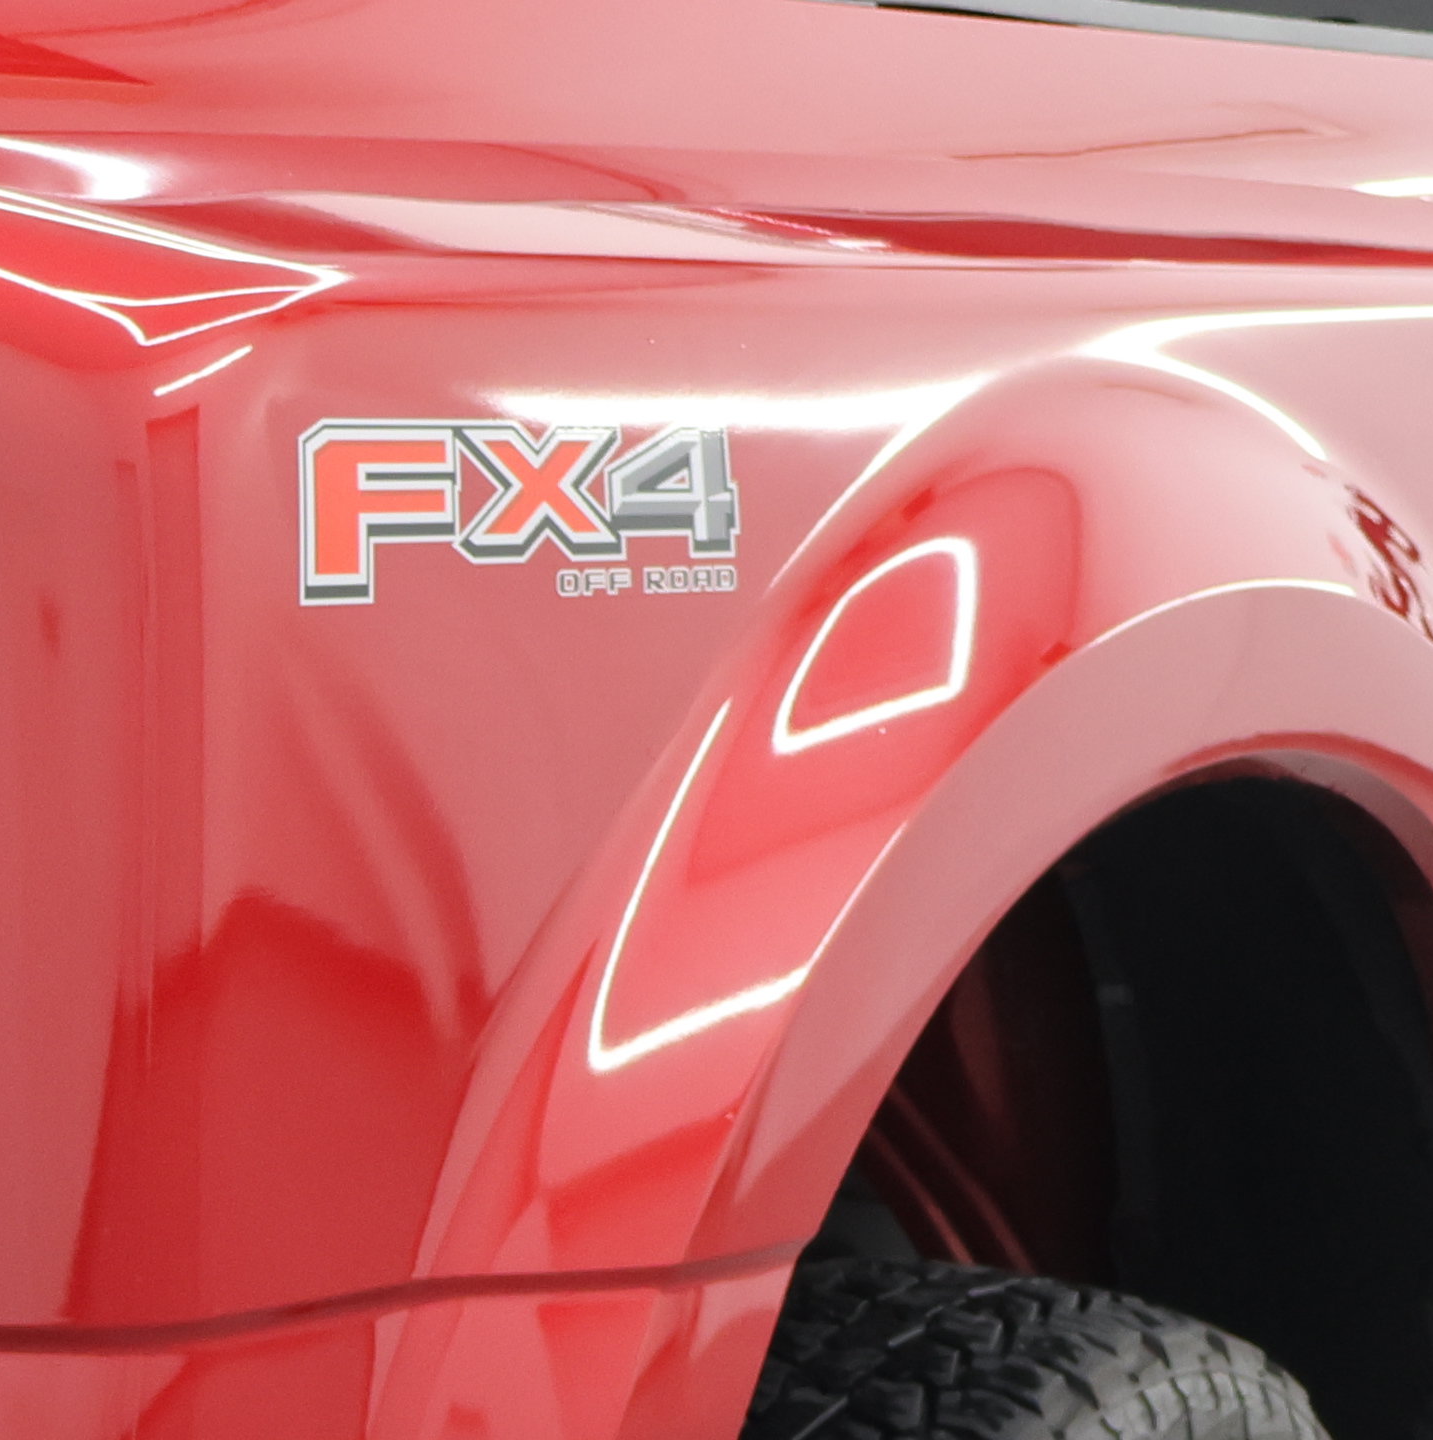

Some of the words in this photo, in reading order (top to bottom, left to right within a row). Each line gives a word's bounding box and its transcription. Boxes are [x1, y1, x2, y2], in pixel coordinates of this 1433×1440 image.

[299, 418, 741, 606] FX4
[556, 568, 632, 597] OFF
[643, 565, 737, 594] ROAD
